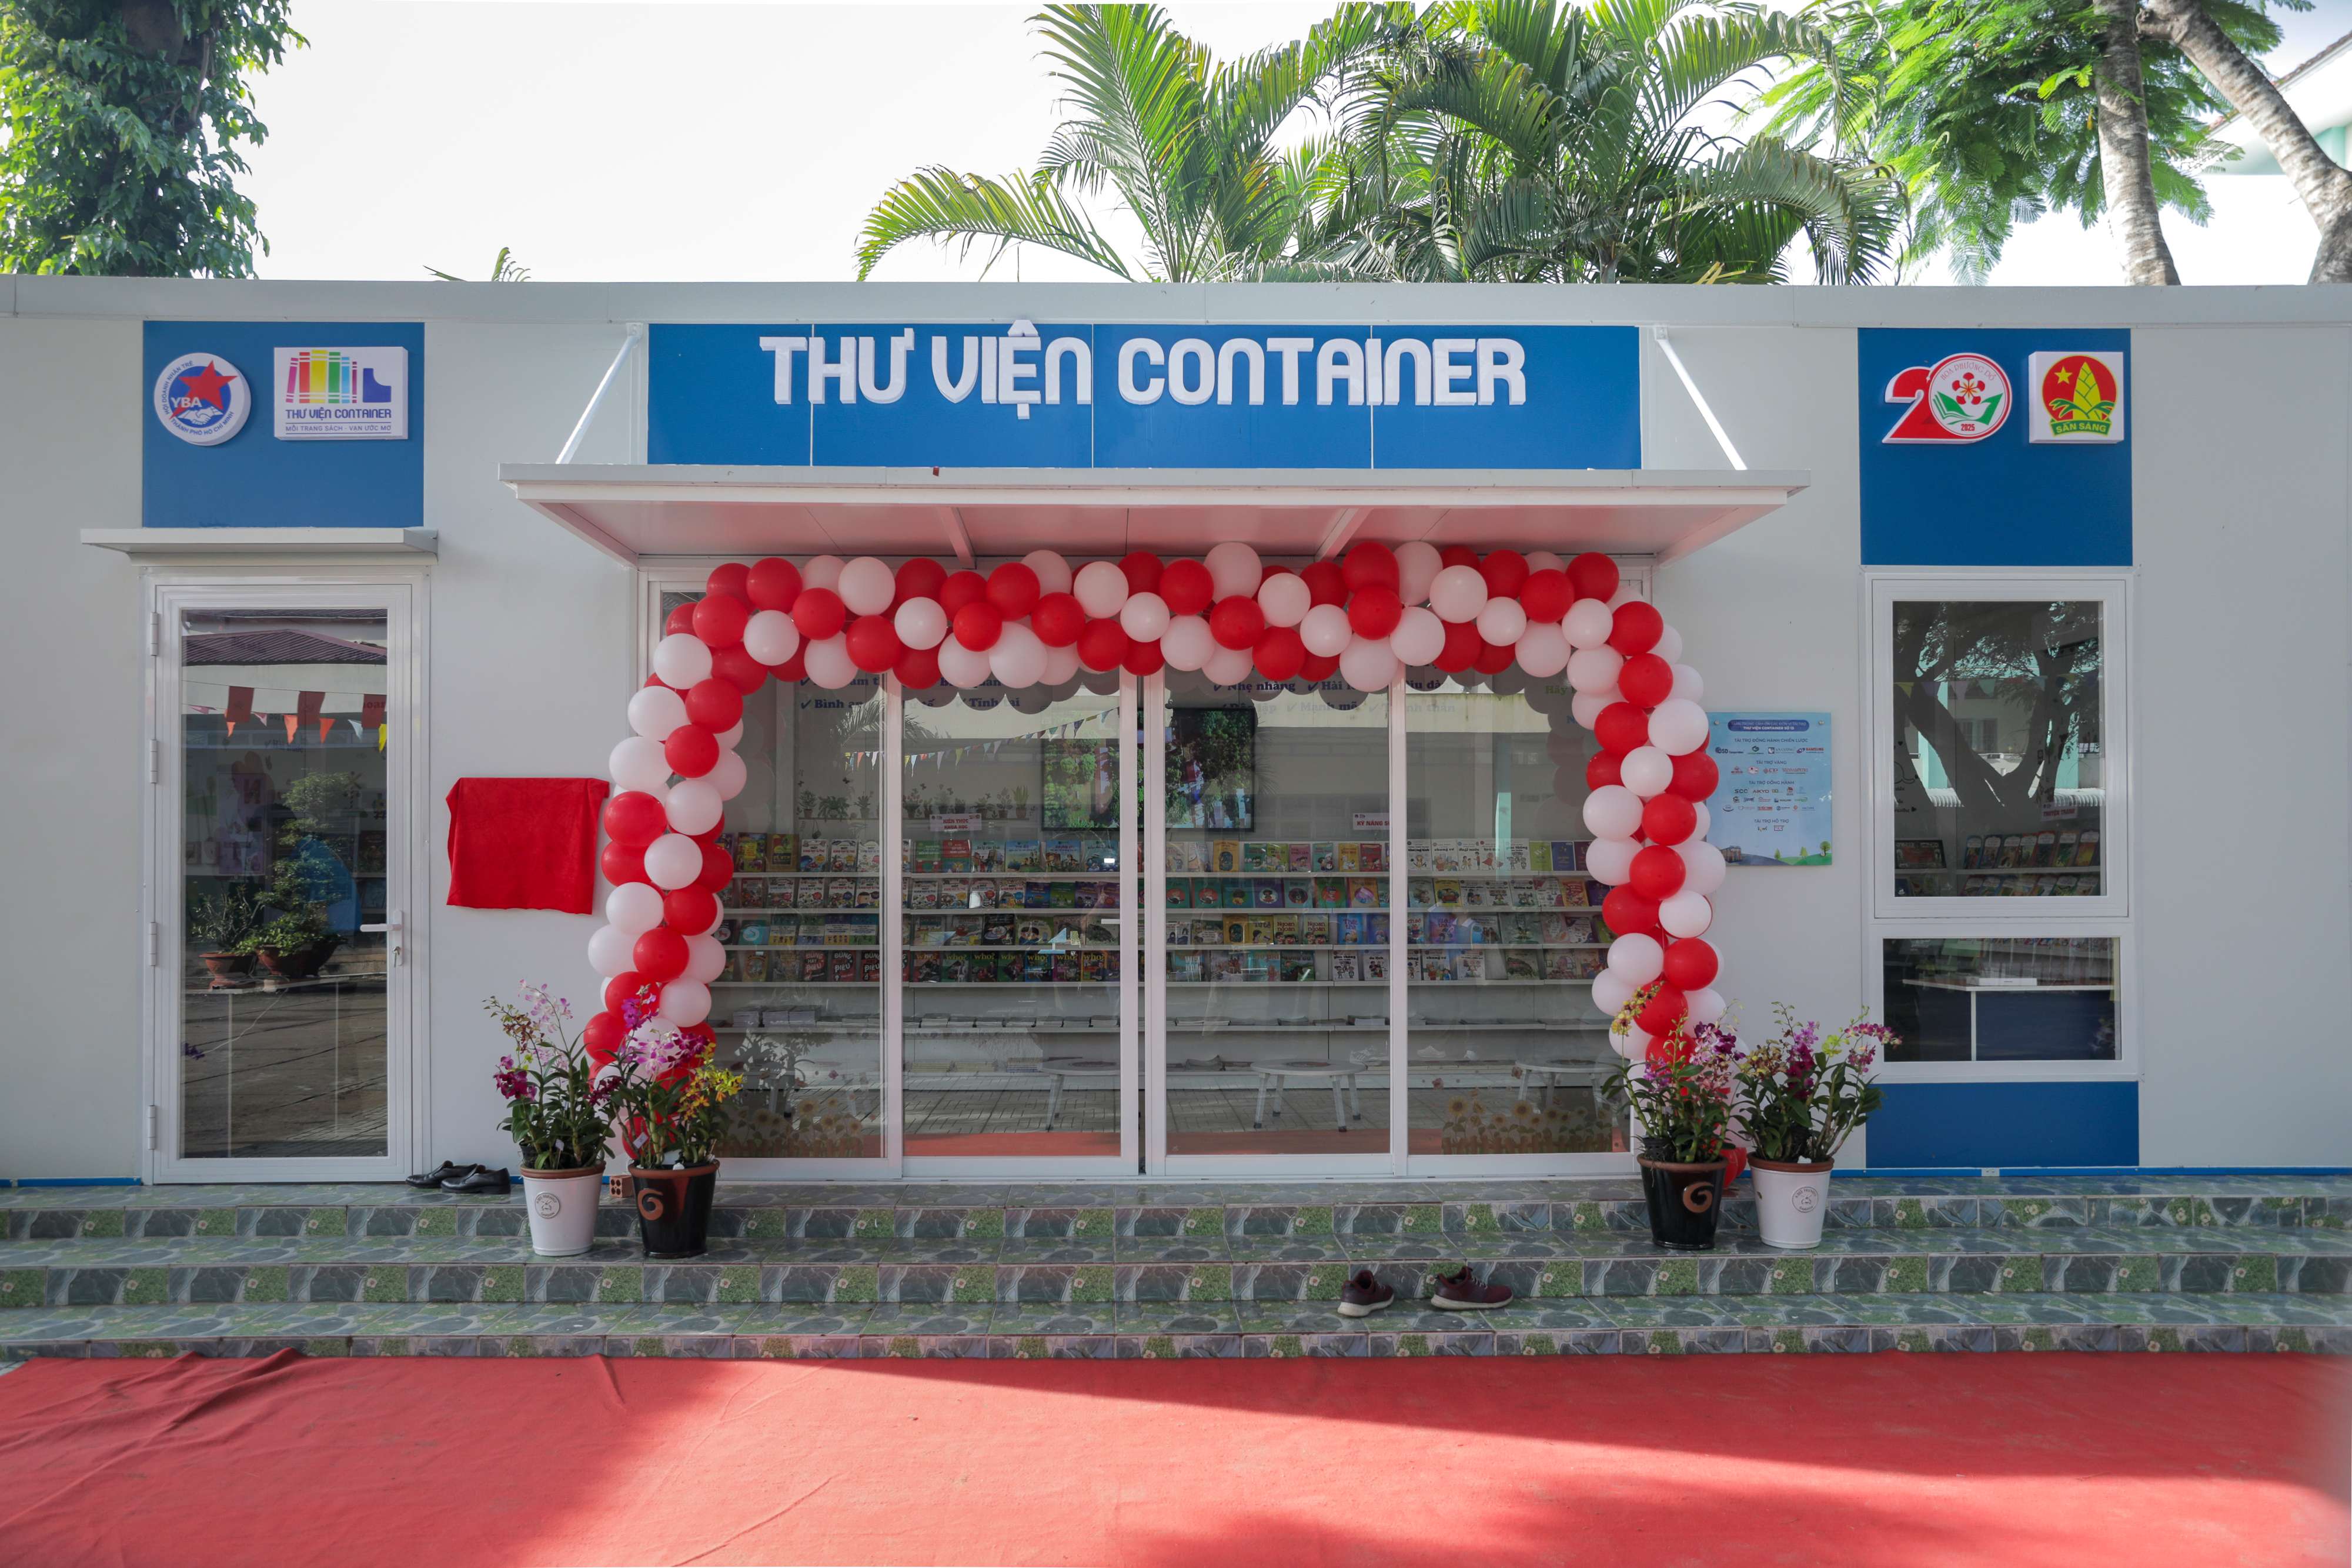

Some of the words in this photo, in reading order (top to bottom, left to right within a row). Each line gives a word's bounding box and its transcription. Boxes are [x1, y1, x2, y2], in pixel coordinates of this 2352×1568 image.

[167, 367, 181, 382] NHÂN
[759, 328, 914, 406] THƯ
[932, 319, 1093, 420] VIỆN
[1118, 337, 1527, 406] CONTAINER
[1940, 369, 1954, 381] HOA
[162, 382, 170, 403] DOANH
[170, 396, 202, 408] YBA
[162, 404, 170, 414] HỘI
[286, 409, 307, 419] THƯ
[309, 407, 332, 421] VIỆN
[335, 409, 392, 419] CONTAINER
[170, 418, 189, 433] THÀNH
[189, 427, 203, 436] PHỐ
[213, 424, 223, 432] CHÍ
[223, 411, 235, 426] MINH
[1960, 423, 1975, 432] 2025
[2079, 422, 2107, 433] SÀNG
